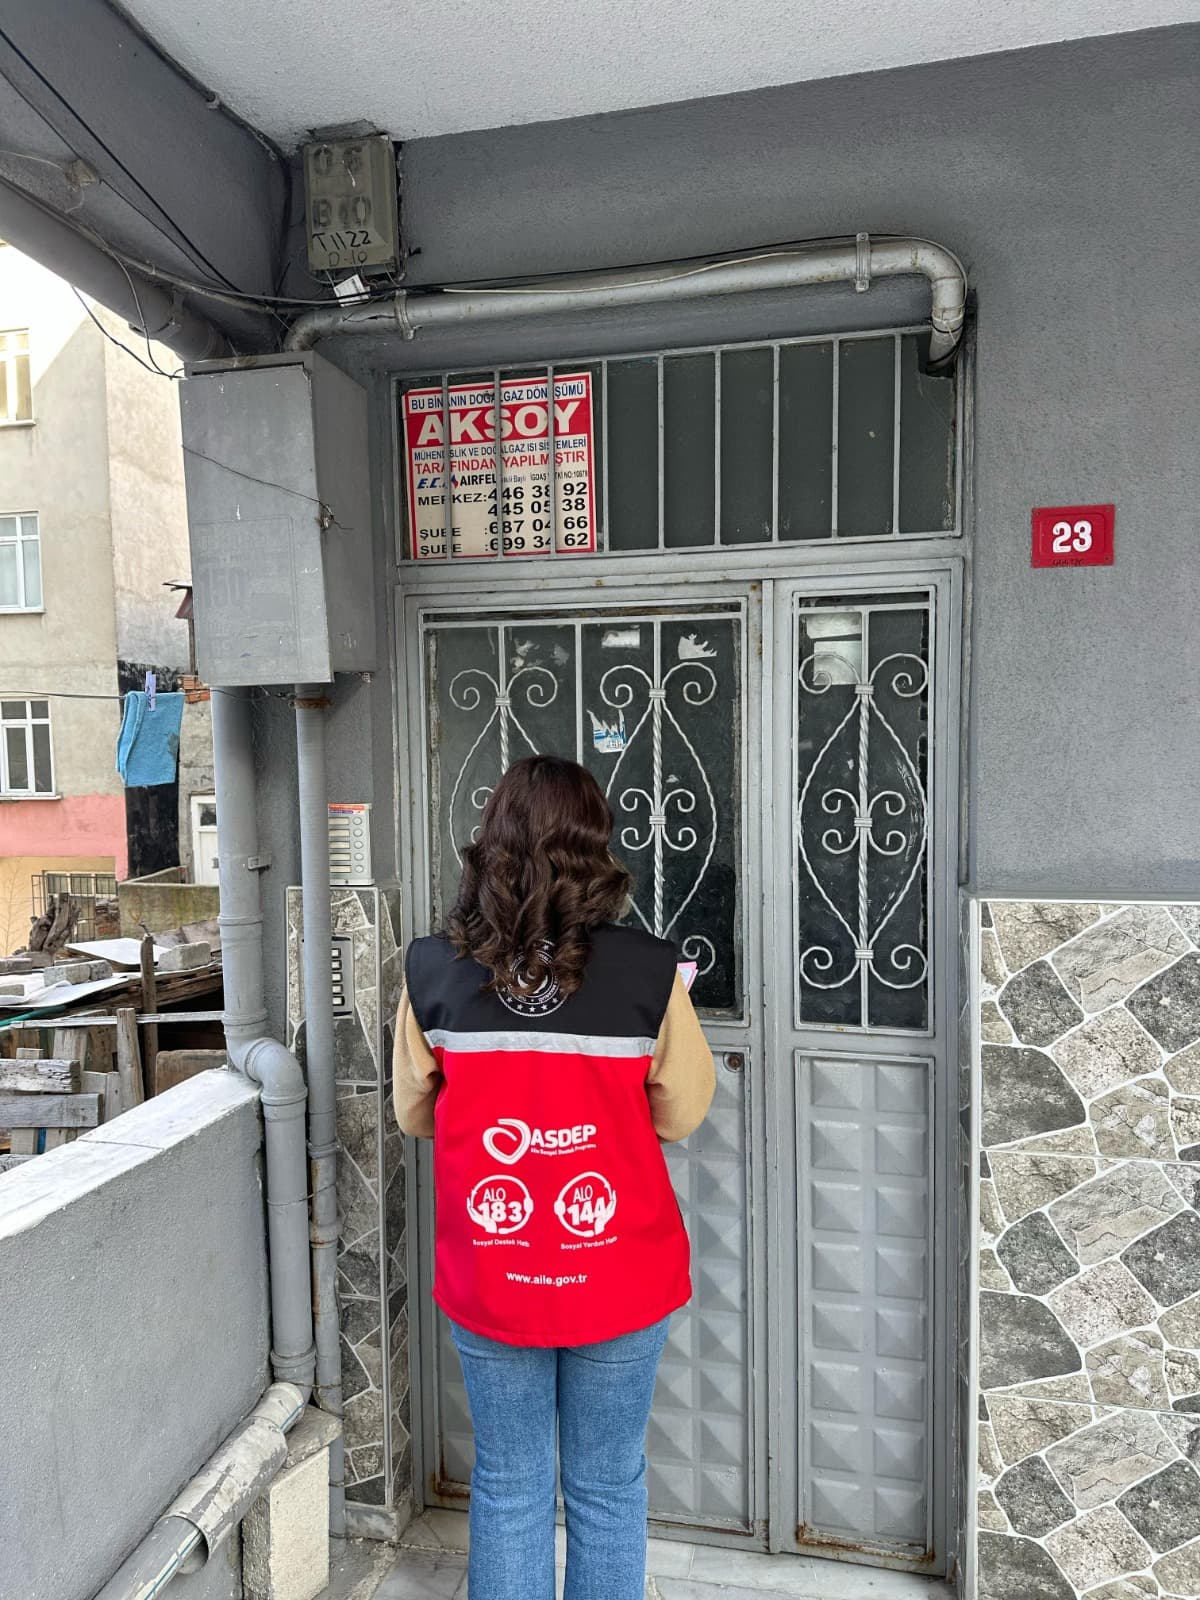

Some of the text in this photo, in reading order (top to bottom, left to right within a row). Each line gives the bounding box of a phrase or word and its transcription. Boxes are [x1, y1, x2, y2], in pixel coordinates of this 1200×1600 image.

[411, 399, 425, 410] BU
[417, 401, 580, 446] AKSOY
[469, 448, 479, 456] VE
[460, 473, 497, 486] AIRFEL
[563, 482, 587, 496] 92
[487, 502, 524, 516] 445
[562, 498, 585, 511] 38
[564, 516, 588, 529] 66
[564, 533, 588, 546] 62
[1052, 521, 1092, 553] 23
[530, 1124, 597, 1148] ASDEP
[483, 1187, 506, 1202] ALO
[573, 1184, 593, 1202] ALO
[478, 1200, 523, 1223] 183
[567, 1196, 606, 1226] 144
[506, 1271, 588, 1288] www.aile.gov.tr
